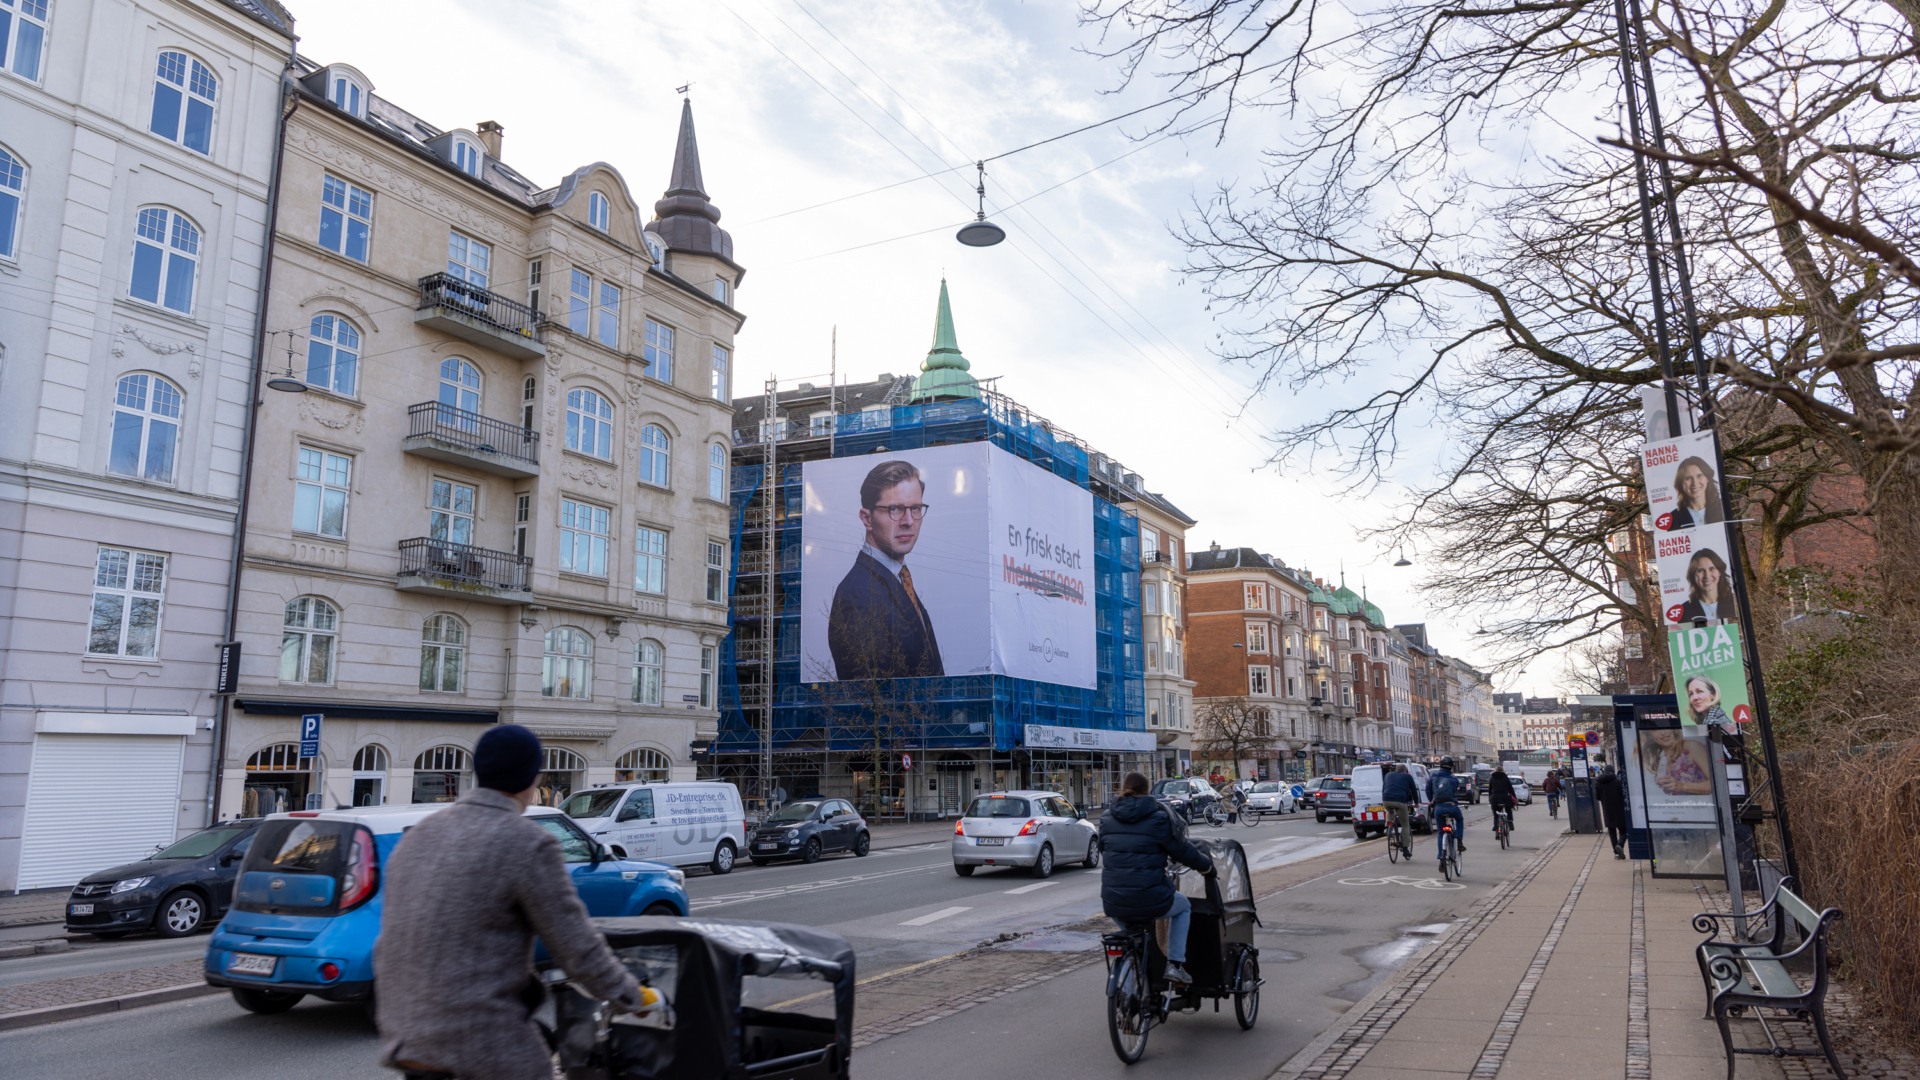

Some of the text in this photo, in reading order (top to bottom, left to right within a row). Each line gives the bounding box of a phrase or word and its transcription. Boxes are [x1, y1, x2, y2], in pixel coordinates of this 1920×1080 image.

[1645, 444, 1678, 459] NANNA
[1646, 453, 1679, 468] BONDE
[1658, 516, 1670, 527] SF
[1008, 524, 1081, 570] En frisk start
[1658, 535, 1691, 548] NANNA
[1659, 544, 1692, 558] BONDE
[1669, 608, 1681, 618] SF
[1676, 625, 1733, 658] IDA
[1028, 642, 1043, 653] Liberal
[1054, 648, 1069, 658] Alliance
[1681, 646, 1735, 672] AUKEN
[219, 647, 229, 692] TERKELSEN
[1738, 709, 1748, 720] A
[305, 718, 316, 739] P
[665, 792, 727, 804] JD-Entreprise.dk
[670, 807, 697, 815] Snedker
